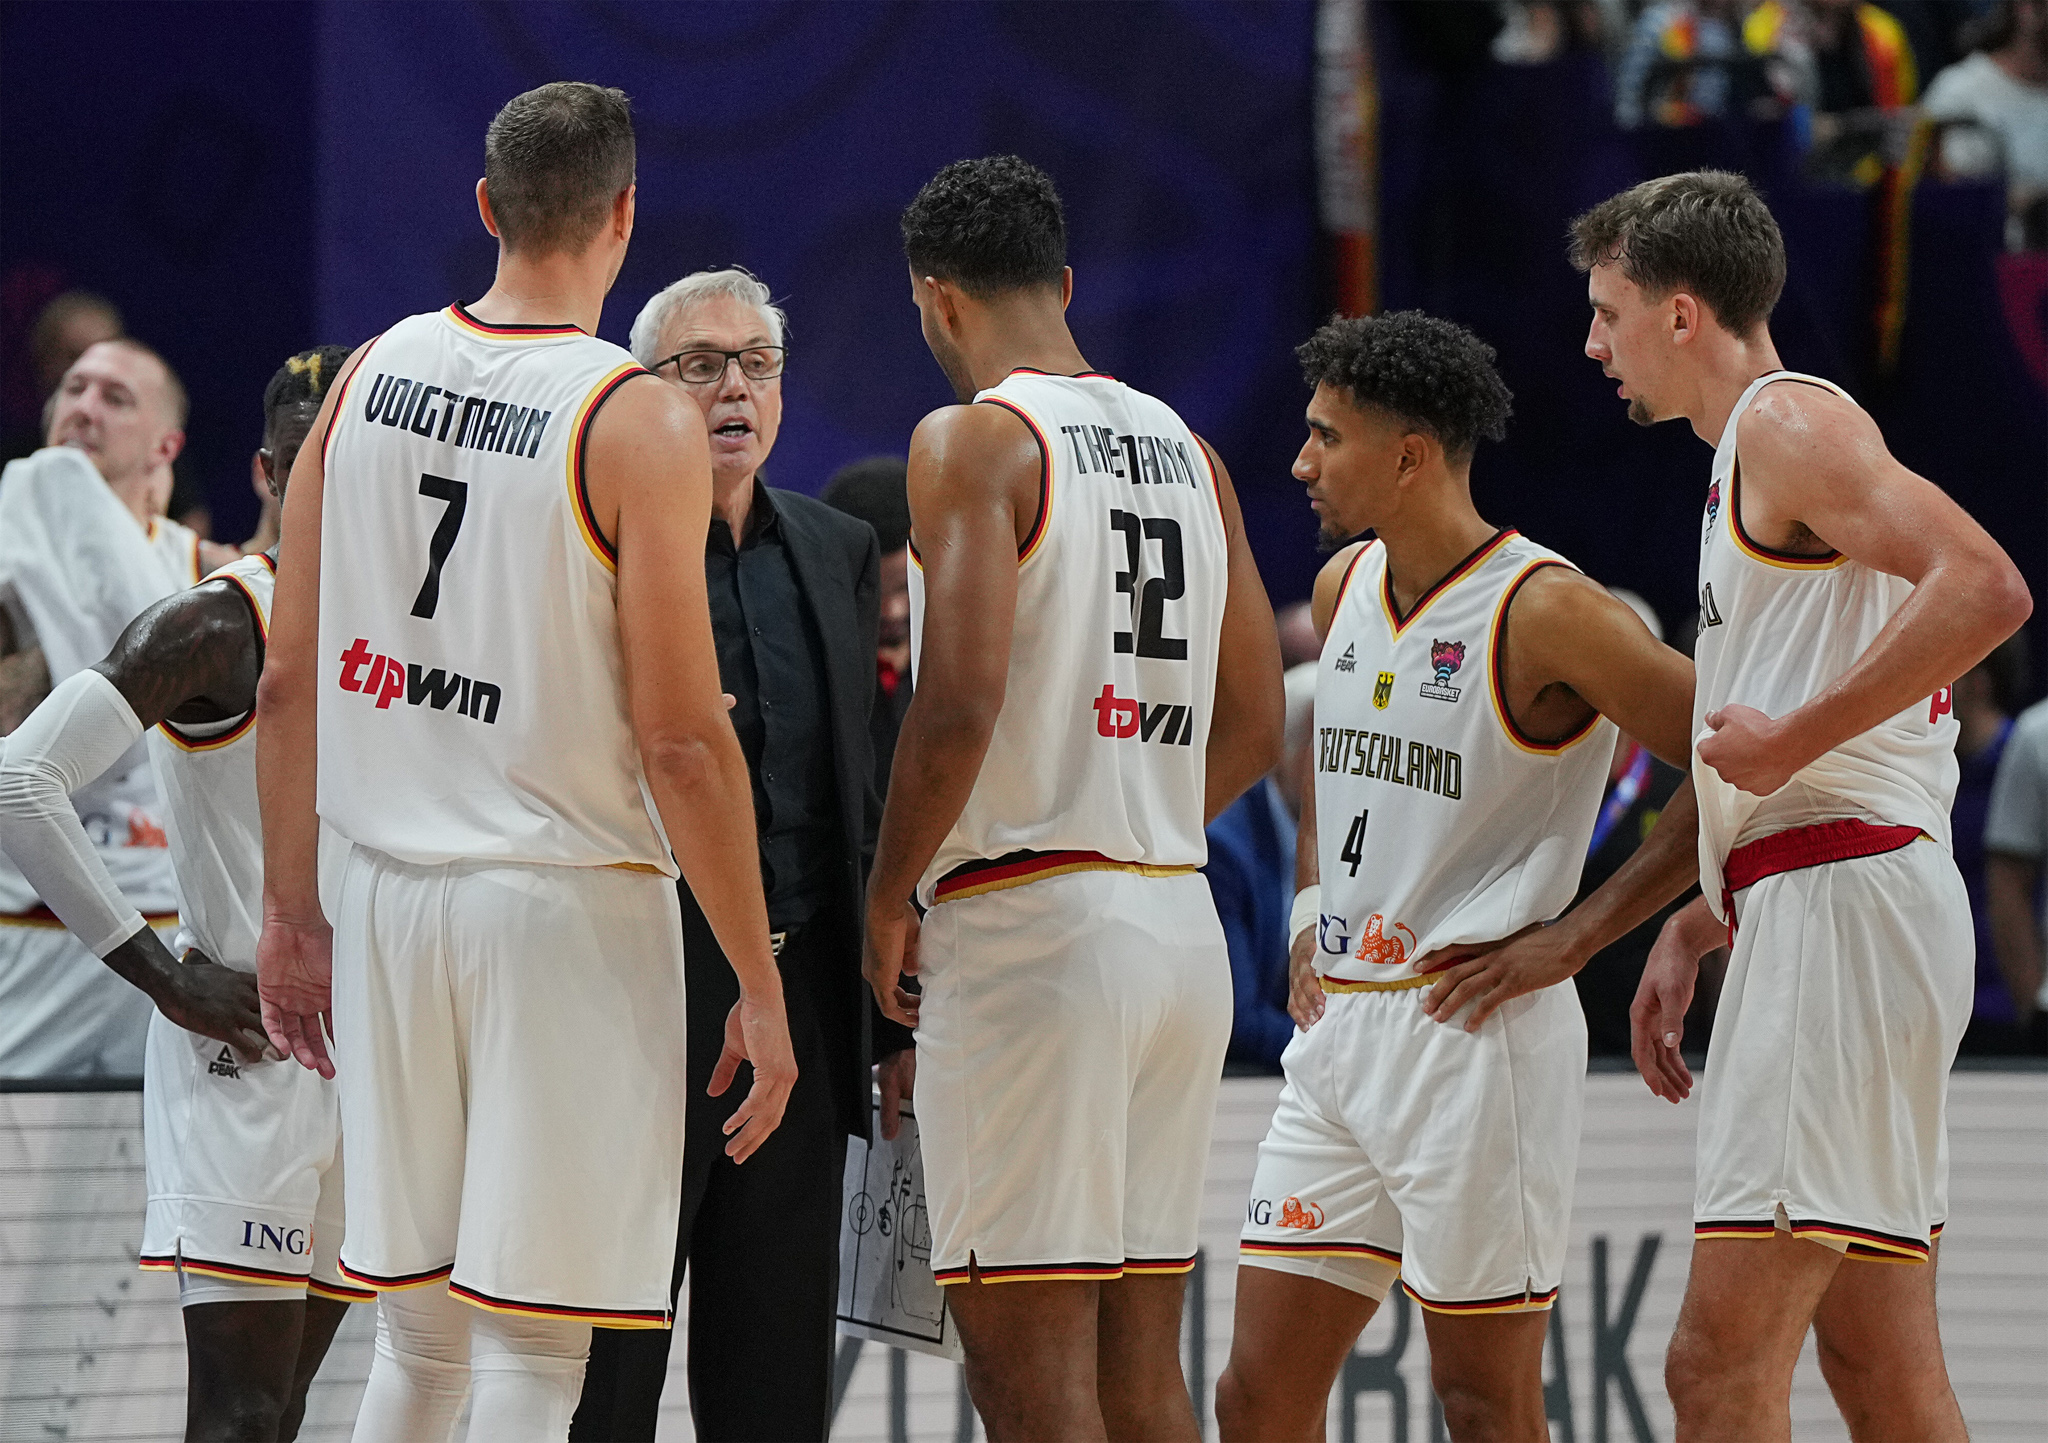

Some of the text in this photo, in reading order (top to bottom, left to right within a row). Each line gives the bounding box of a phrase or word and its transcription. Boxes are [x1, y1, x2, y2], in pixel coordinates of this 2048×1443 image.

[365, 373, 552, 459] VOIGTMANN
[410, 472, 468, 619] 7
[1110, 509, 1187, 660] 32
[339, 638, 502, 724] tipwin
[1335, 658, 1357, 673] PEAK
[1340, 808, 1369, 877] 4
[1320, 913, 1351, 955] NG
[208, 1061, 241, 1079] PEAK
[240, 1220, 305, 1255] ING
